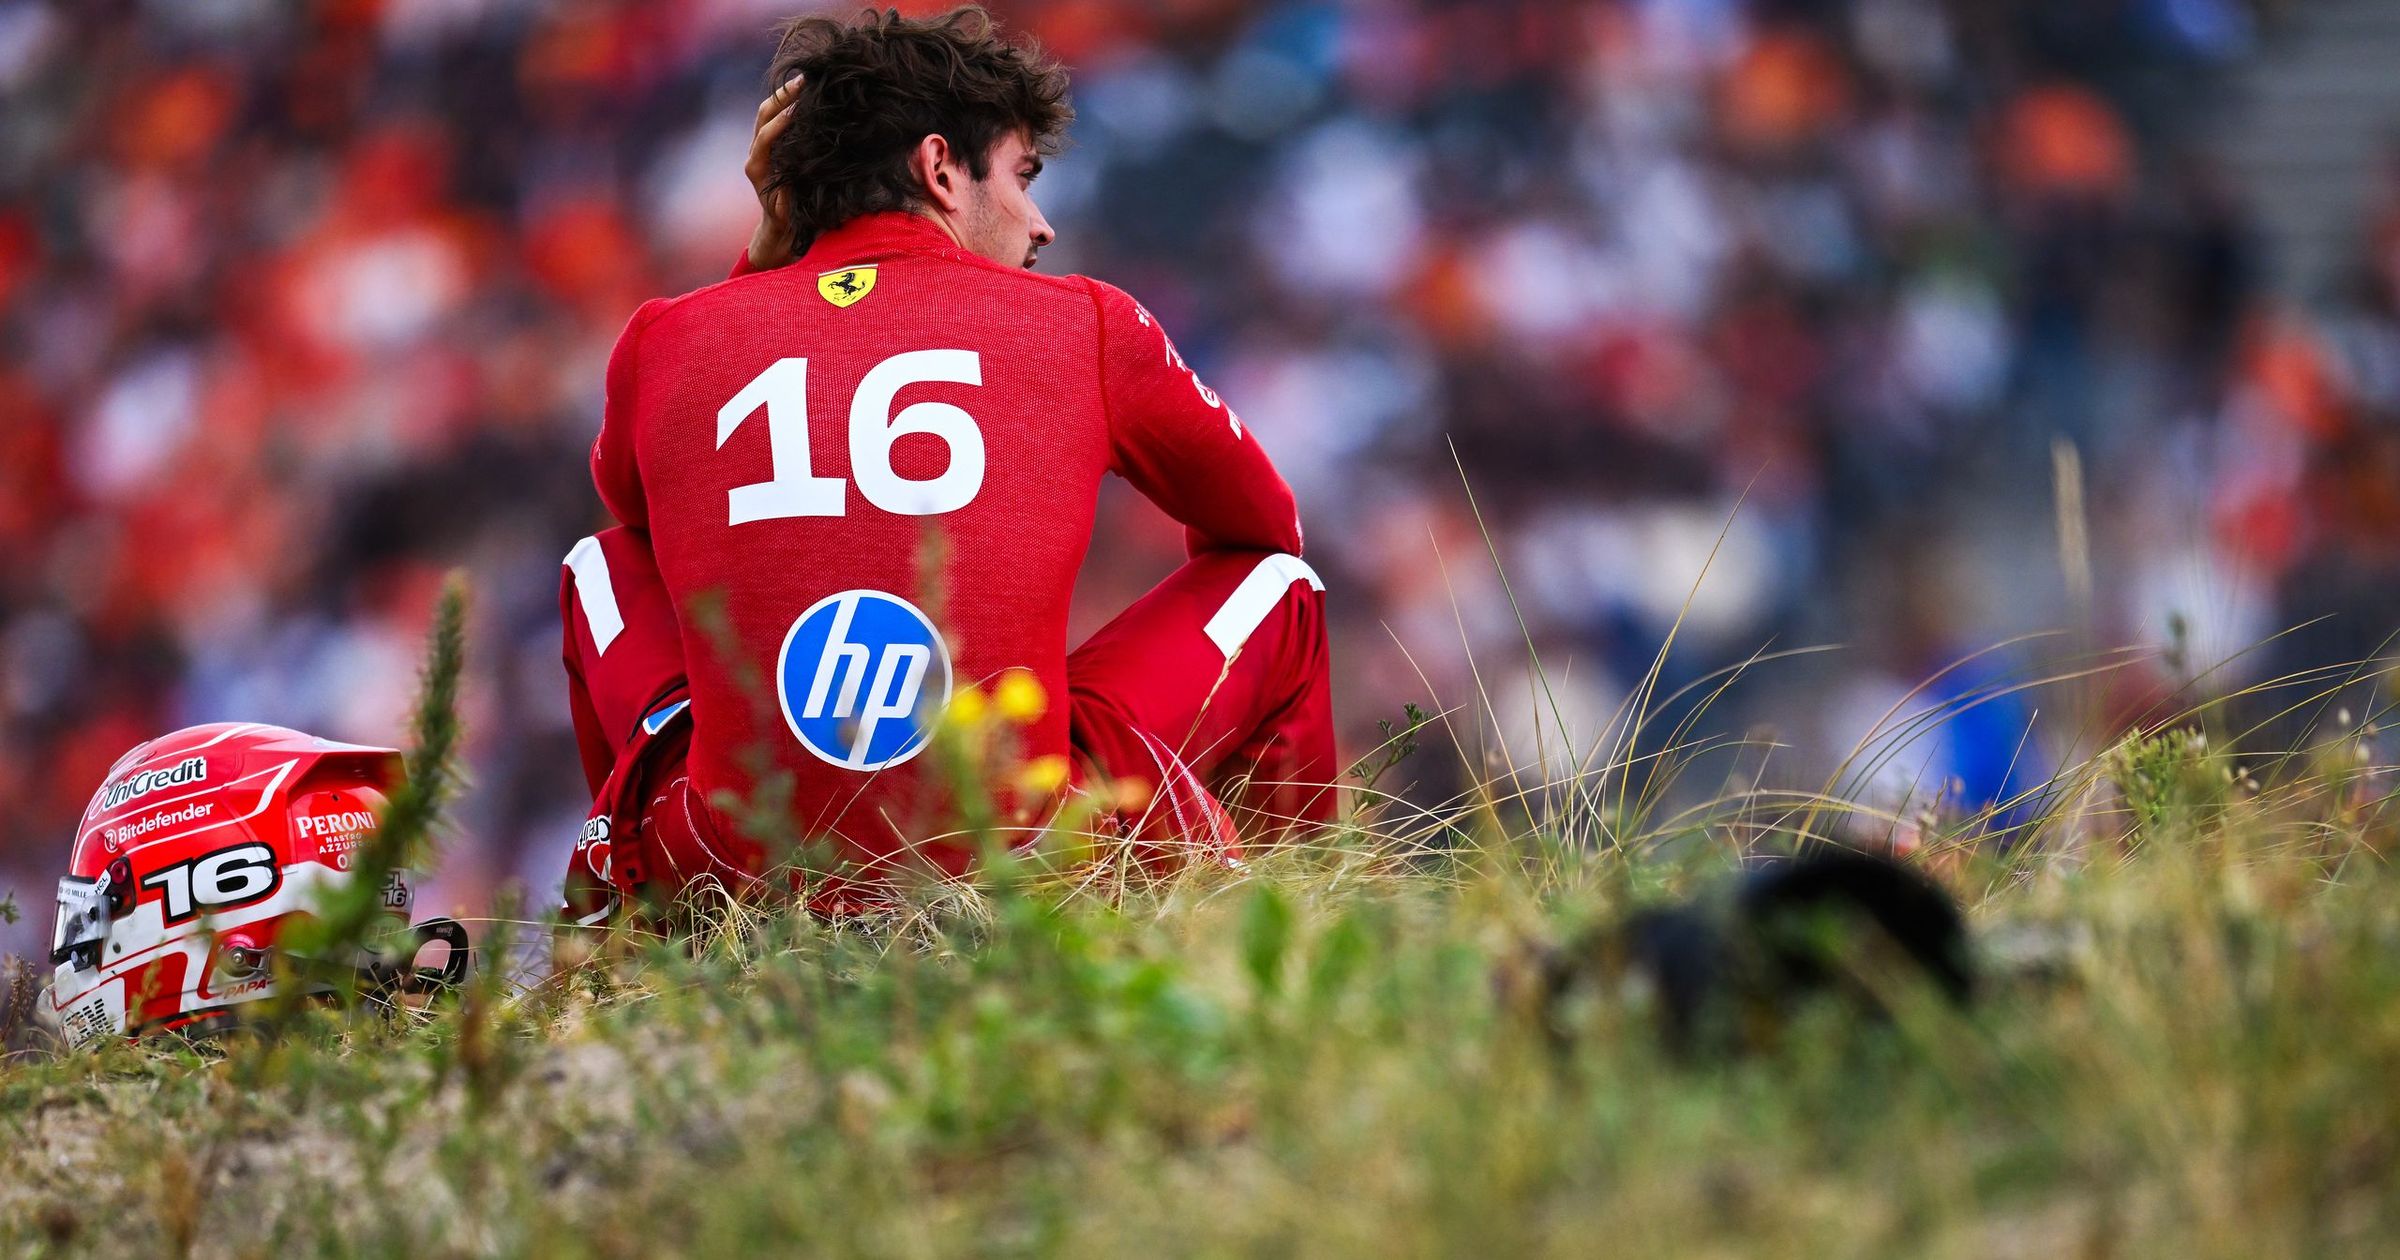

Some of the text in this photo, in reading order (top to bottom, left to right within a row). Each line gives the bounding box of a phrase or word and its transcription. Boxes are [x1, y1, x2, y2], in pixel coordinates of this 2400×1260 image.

[716, 348, 986, 527] 16
[800, 595, 933, 767] hp
[104, 757, 205, 810] UniCredit
[118, 802, 214, 845] Bitdefender
[296, 811, 377, 839] PERONI
[325, 832, 362, 844] NASTRO
[319, 840, 371, 855] AZZUR
[142, 844, 276, 921] 16
[382, 888, 408, 908] 16
[224, 978, 268, 999] PAPA
